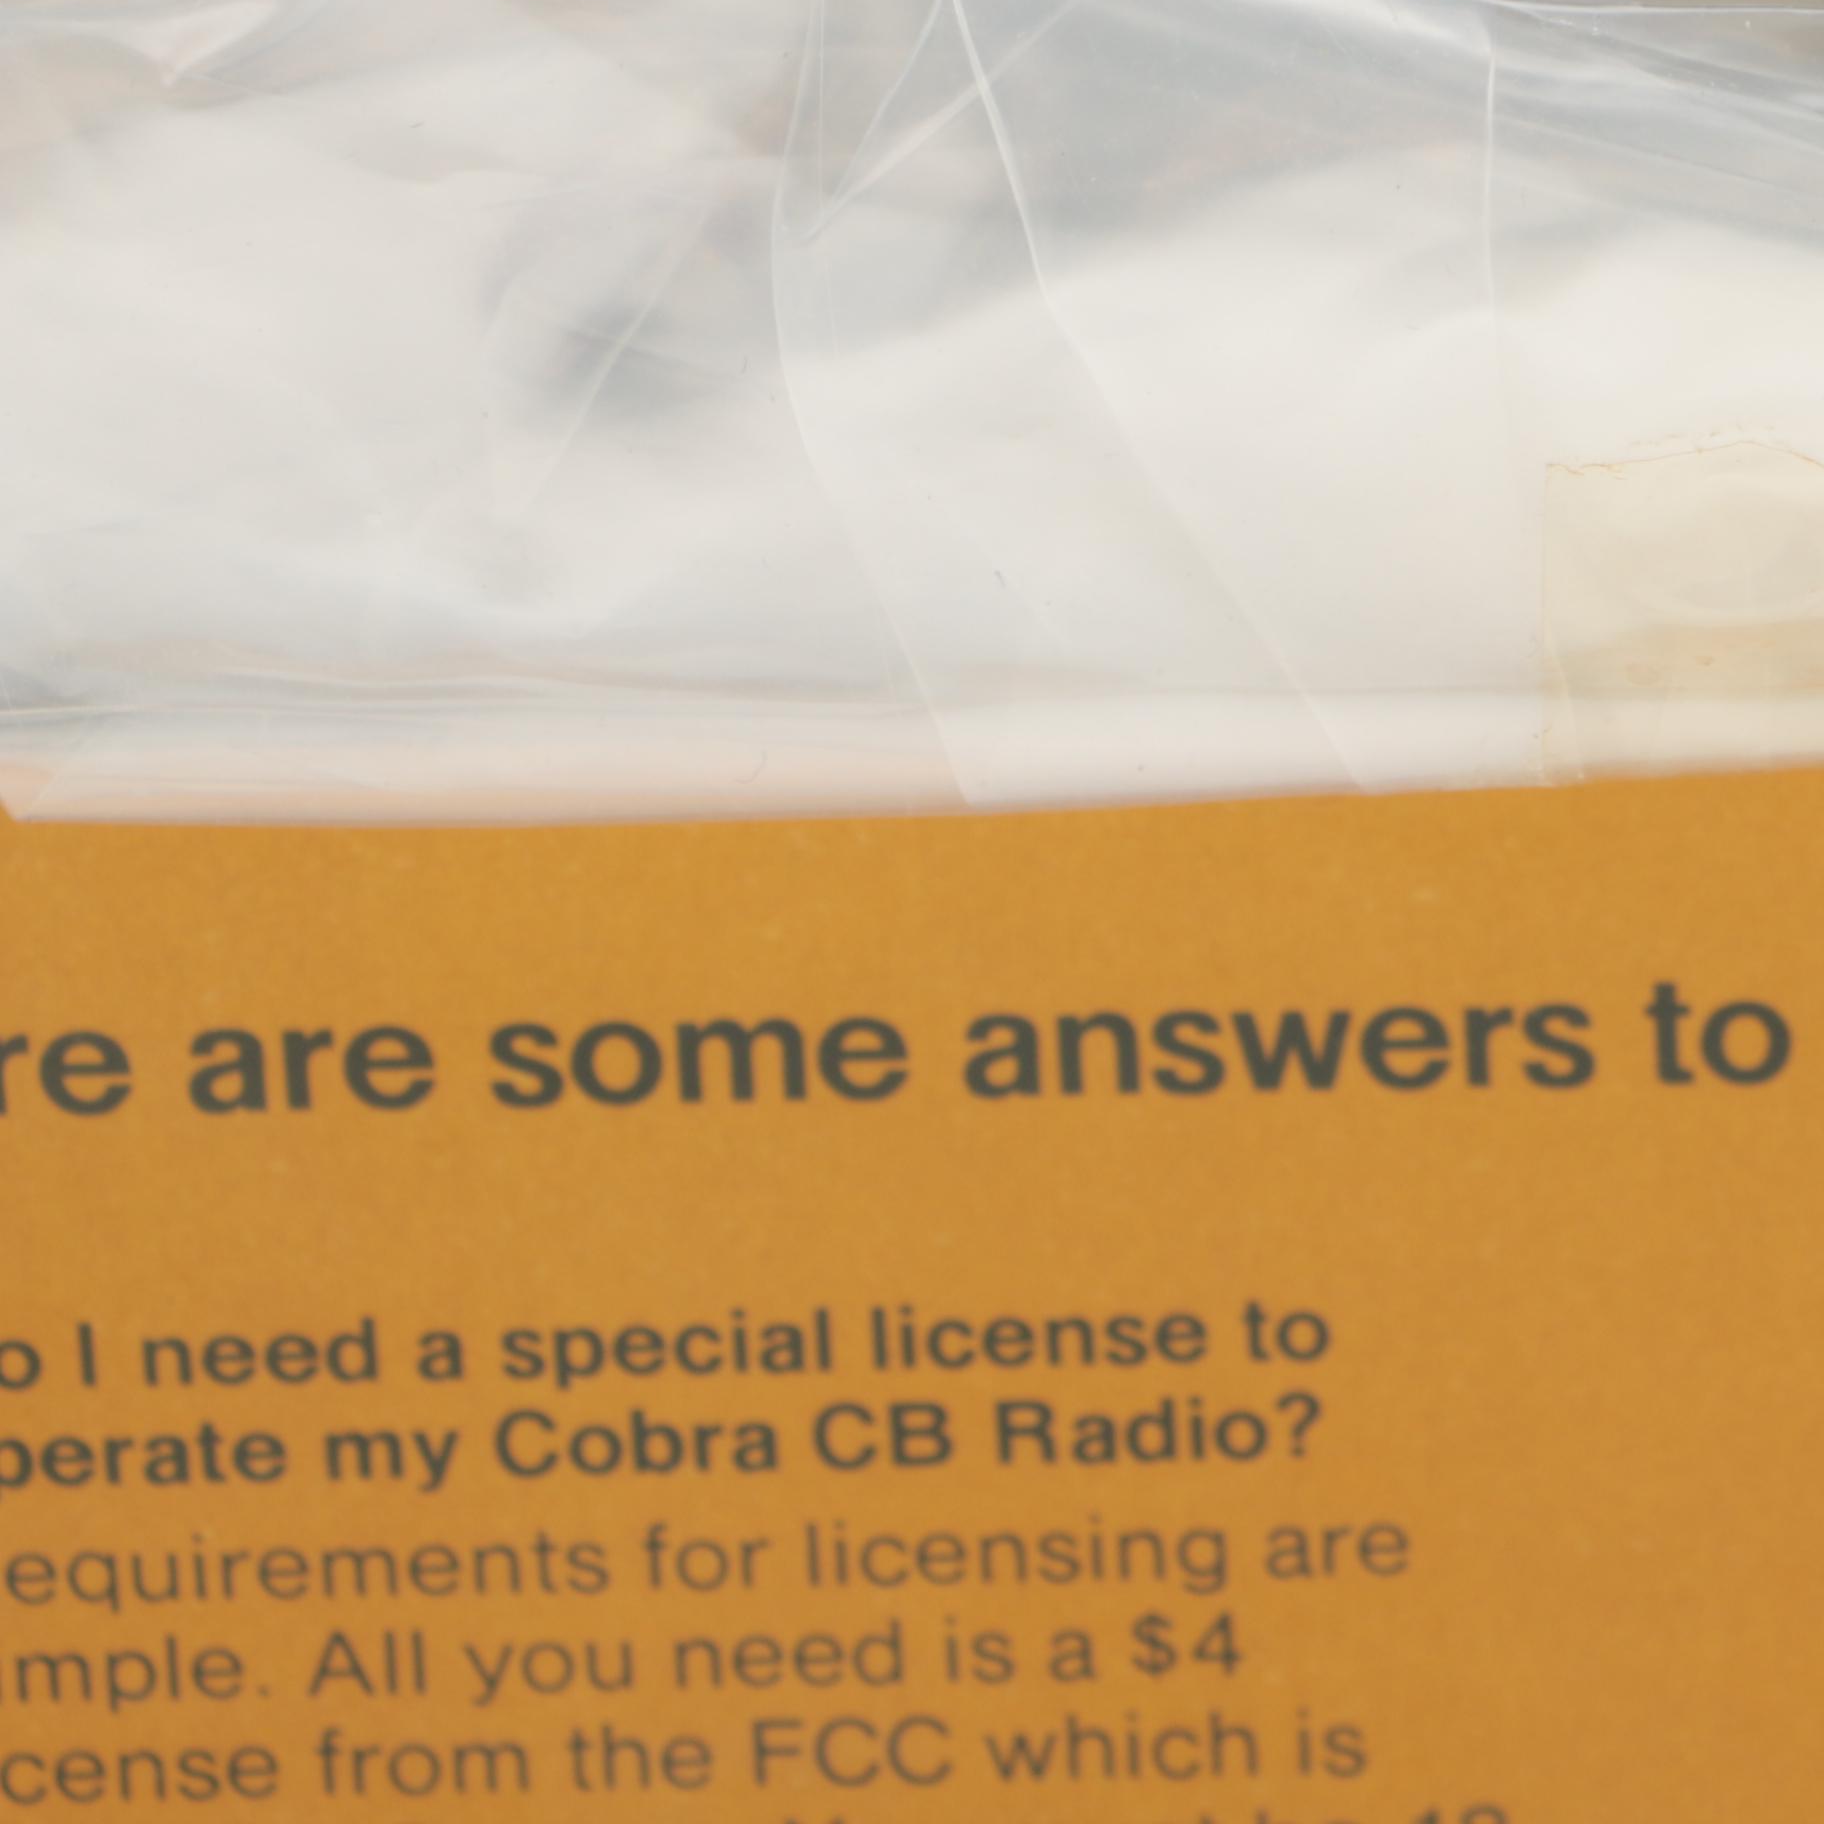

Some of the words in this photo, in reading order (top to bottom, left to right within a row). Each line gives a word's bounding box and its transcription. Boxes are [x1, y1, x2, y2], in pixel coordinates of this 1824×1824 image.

[185, 1021, 439, 1118] are
[485, 1012, 912, 1113] some
[960, 999, 1600, 1103] answers
[1641, 977, 1796, 1090] to
[74, 1319, 100, 1390] I
[138, 1313, 382, 1389] need
[414, 1327, 468, 1385] a
[498, 1304, 836, 1393] special
[867, 1301, 1211, 1374] license
[1239, 1298, 1334, 1366] to
[321, 1427, 462, 1495] my
[490, 1405, 782, 1482] Cobra
[809, 1398, 957, 1474] CB
[991, 1387, 1325, 1469] Radio?
[1, 1530, 612, 1615] equirements
[640, 1520, 770, 1593] for
[803, 1521, 1230, 1598] licensing
[1263, 1521, 1412, 1582] are
[0, 1632, 274, 1715] mple.
[306, 1627, 429, 1698] All
[462, 1640, 636, 1708] you
[672, 1617, 906, 1690] need
[943, 1630, 1017, 1686] is
[1046, 1627, 1098, 1685] a
[1129, 1609, 1244, 1680] $4
[0, 1744, 282, 1808] cense
[313, 1725, 532, 1799] from
[565, 1722, 715, 1793] the
[749, 1713, 954, 1790] FCC
[983, 1710, 1261, 1784] which
[1296, 1723, 1369, 1780] is
